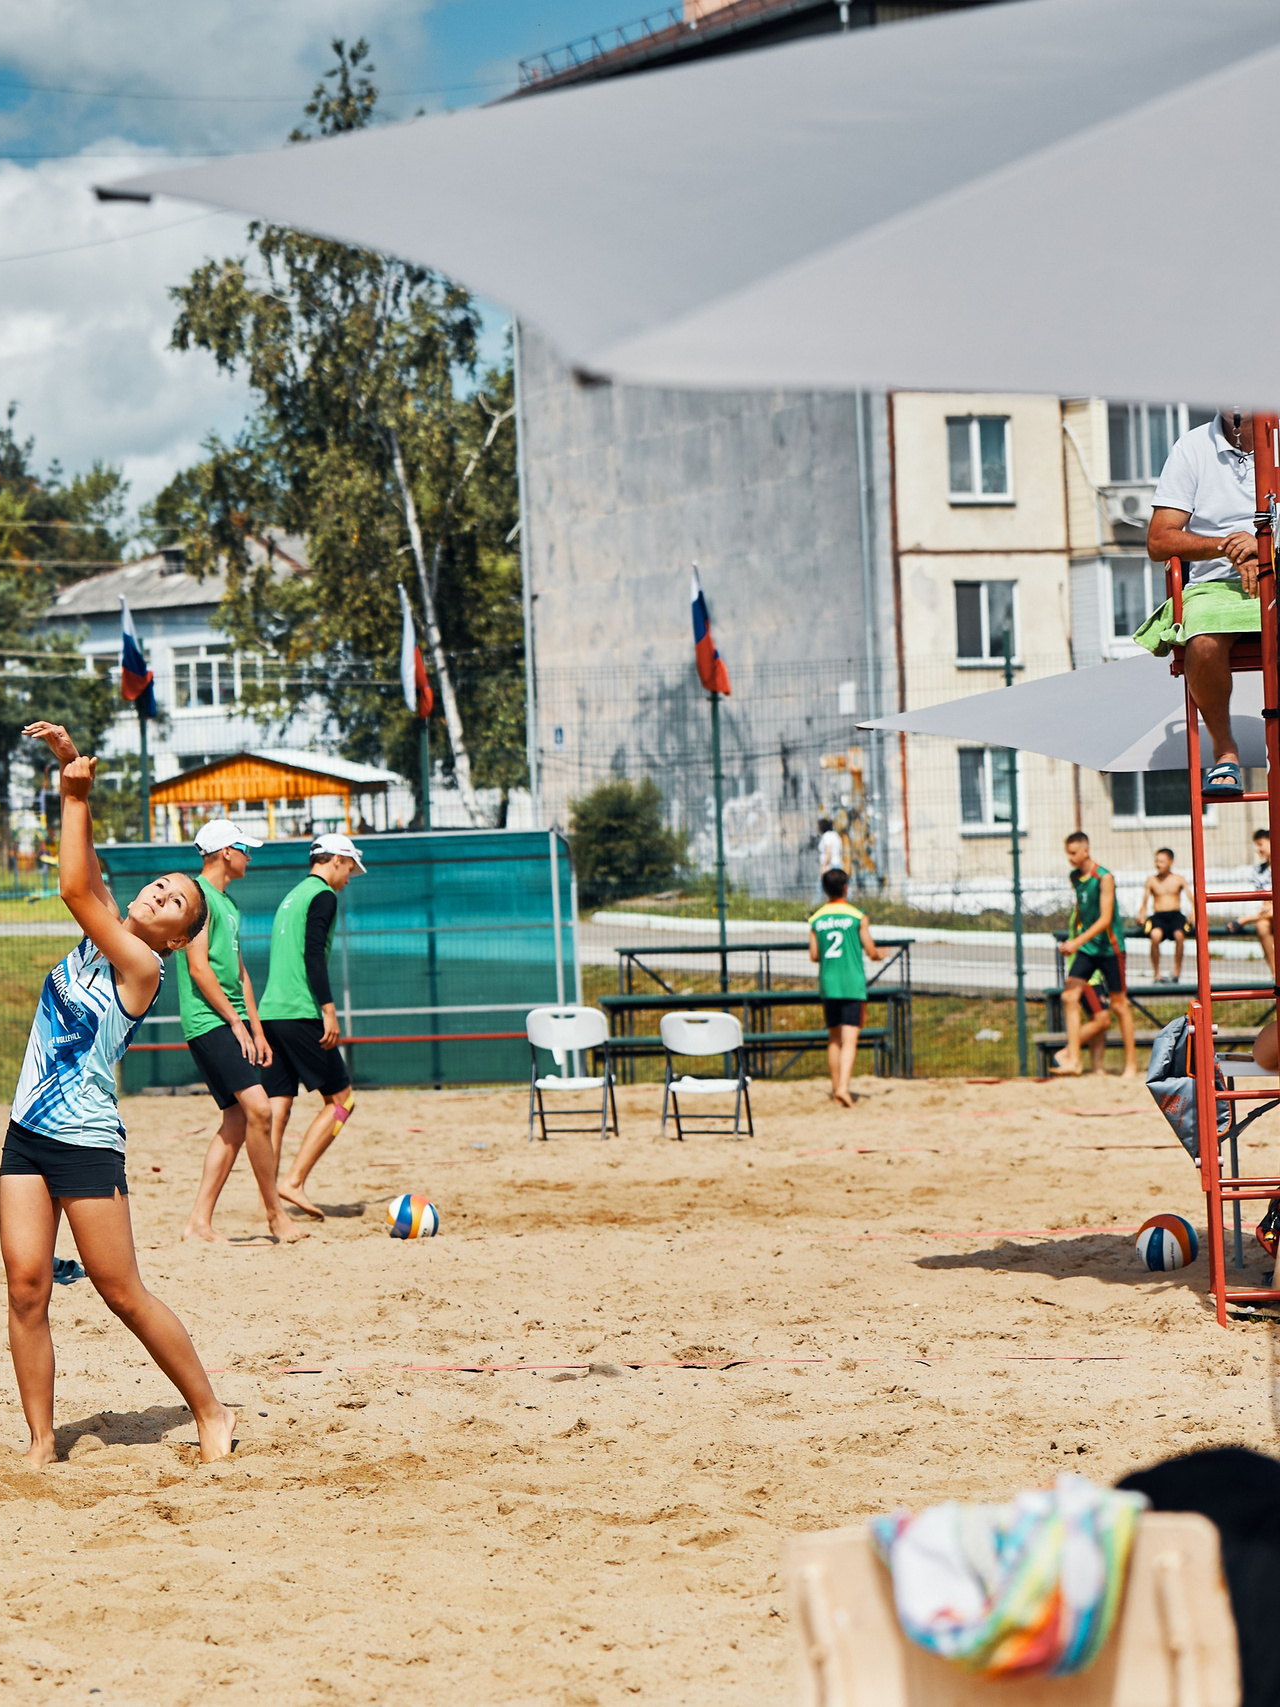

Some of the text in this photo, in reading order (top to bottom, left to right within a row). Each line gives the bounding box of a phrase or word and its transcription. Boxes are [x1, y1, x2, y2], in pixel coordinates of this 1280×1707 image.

[824, 931, 843, 958] 2
[51, 963, 85, 1019] SUMMER 2023
[86, 967, 101, 990] 1
